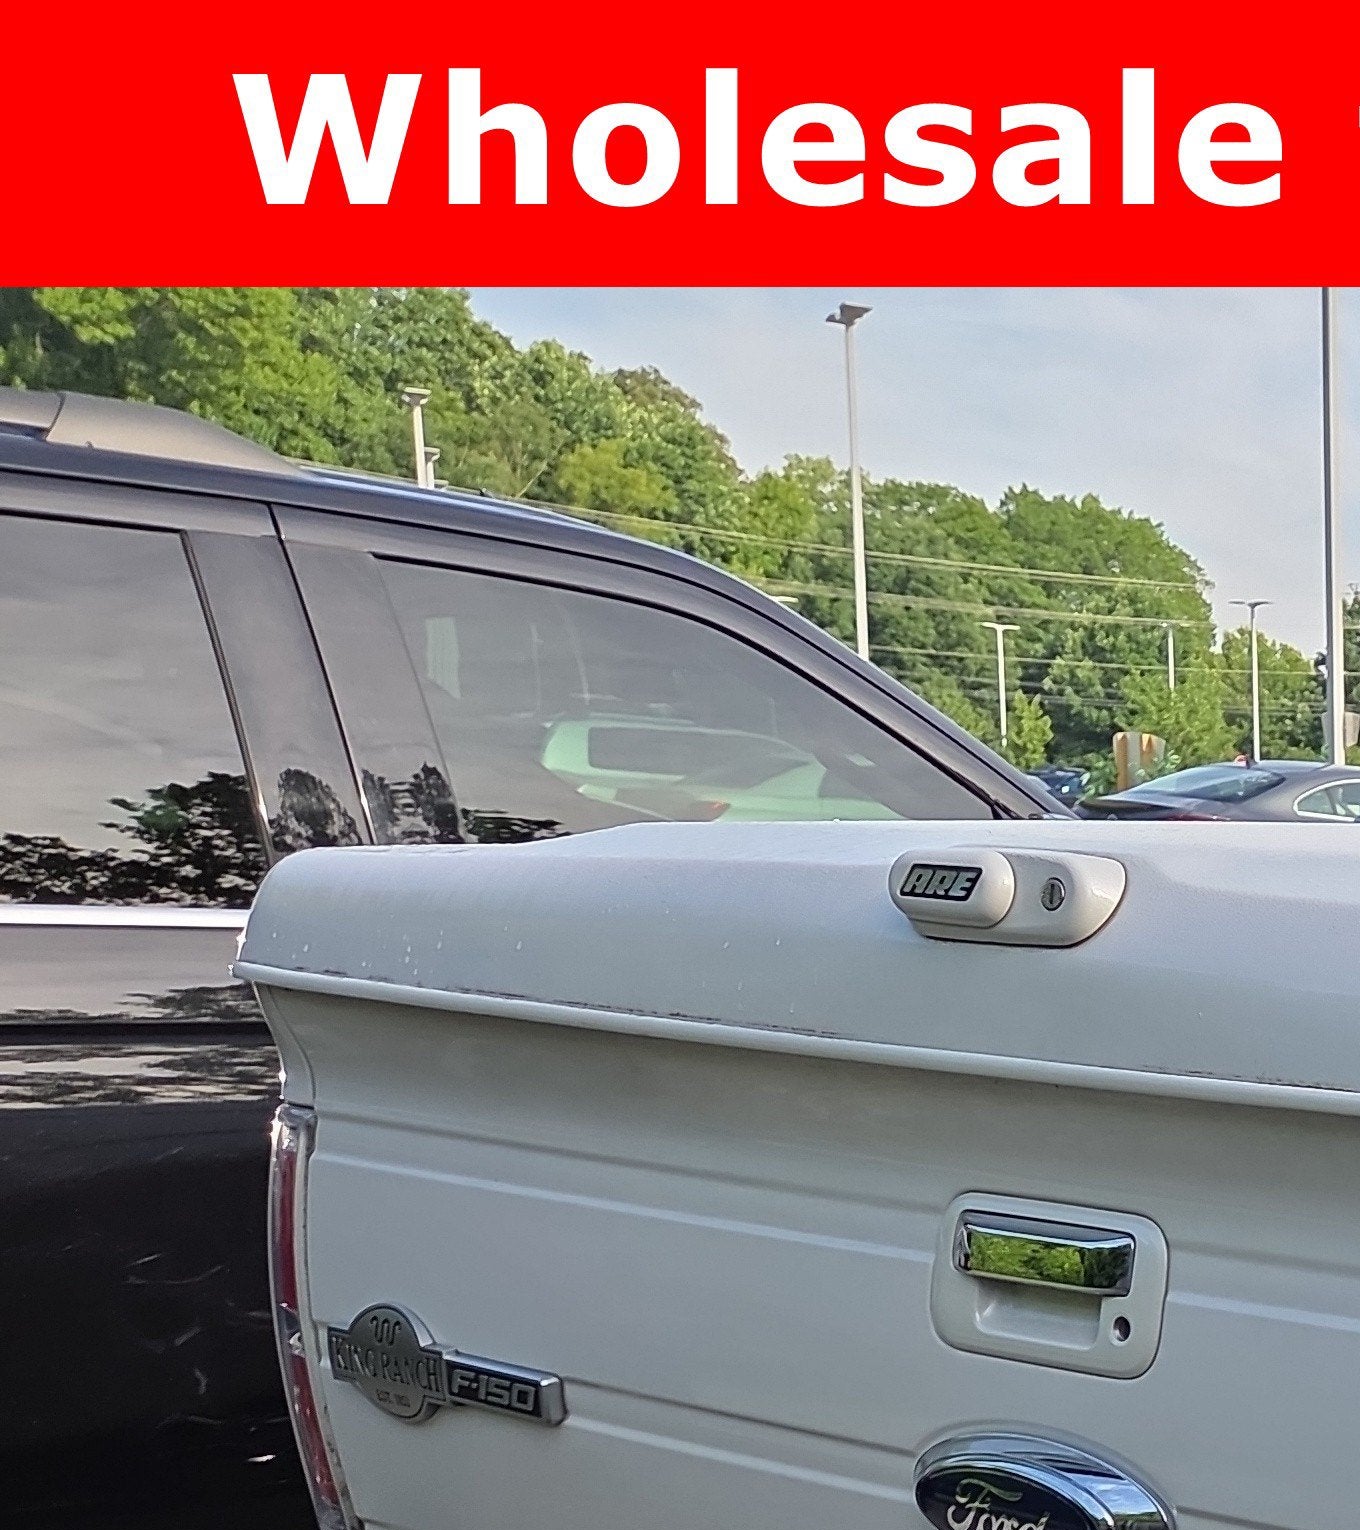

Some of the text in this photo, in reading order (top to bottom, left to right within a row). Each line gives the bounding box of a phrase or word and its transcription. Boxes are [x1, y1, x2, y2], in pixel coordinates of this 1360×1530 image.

[904, 868, 976, 897] ARE
[332, 1336, 441, 1393] KING RANCH
